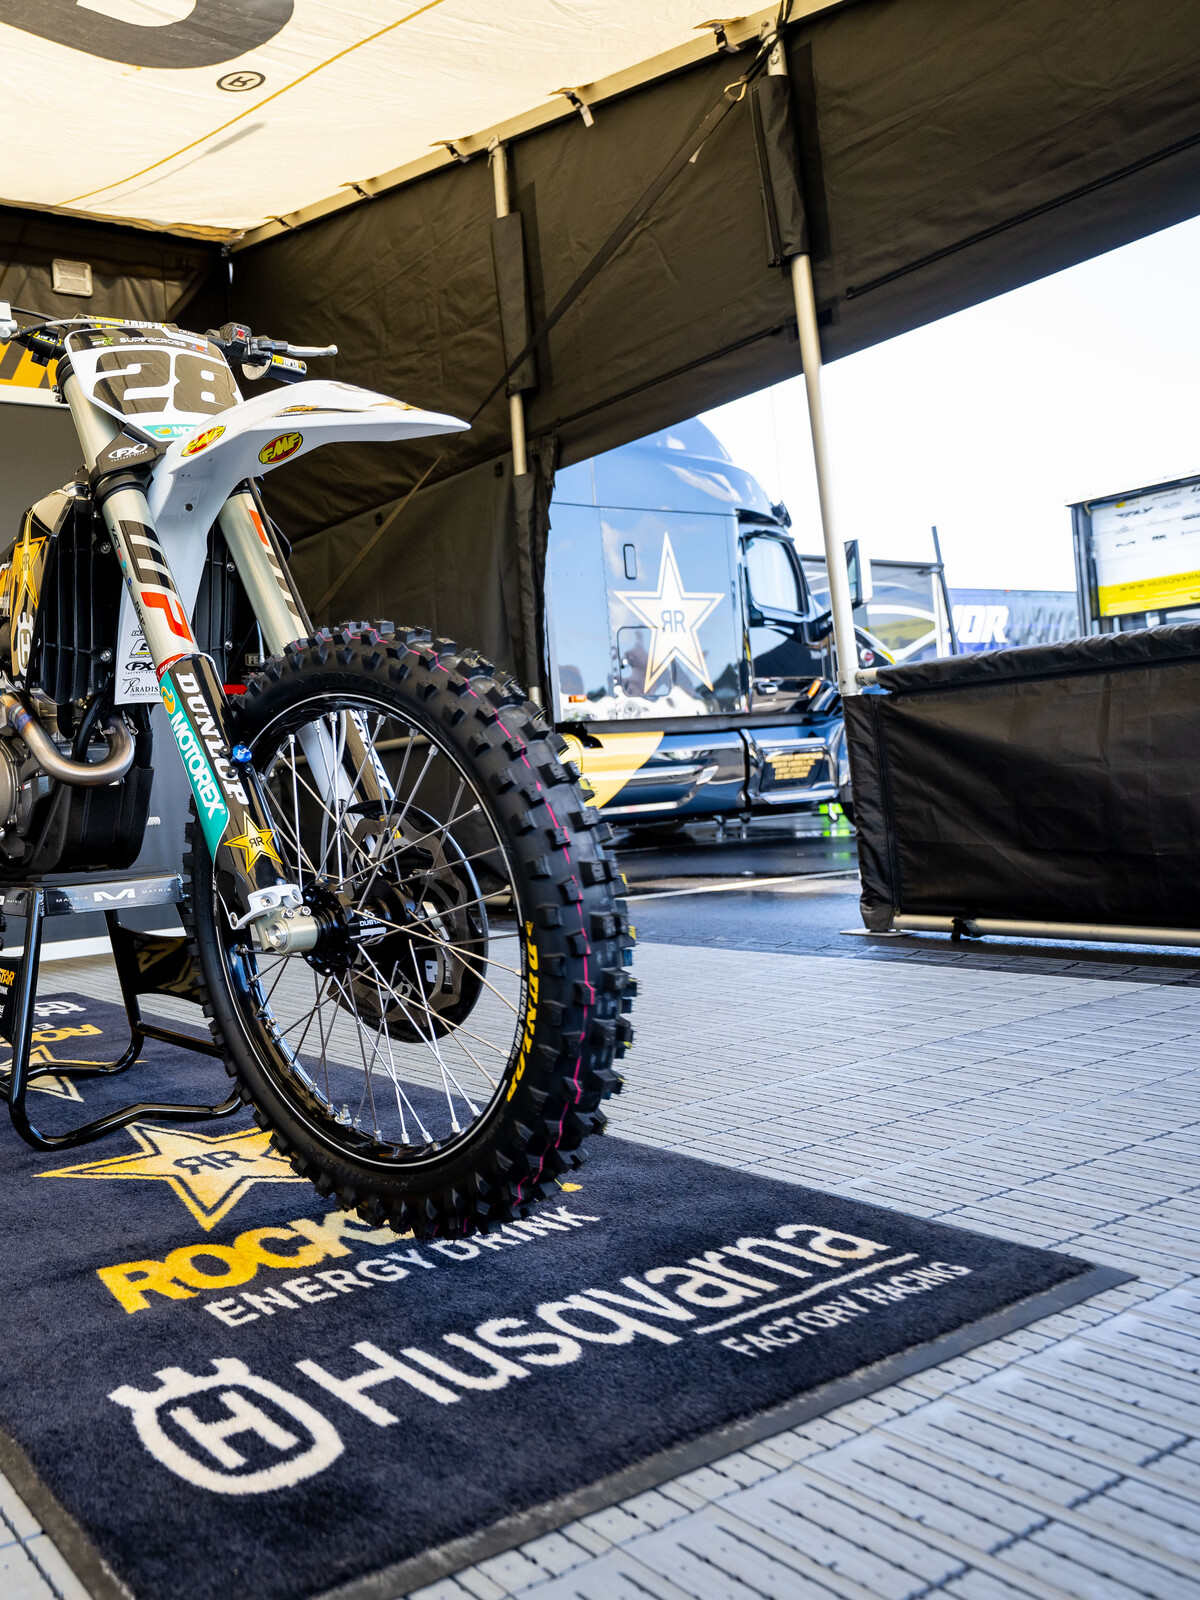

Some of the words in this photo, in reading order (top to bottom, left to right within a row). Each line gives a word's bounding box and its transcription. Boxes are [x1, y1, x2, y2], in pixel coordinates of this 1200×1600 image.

[93, 350, 239, 416] 28
[119, 336, 187, 347] SUPERCROSS
[259, 432, 302, 465] FMF
[170, 711, 226, 820] MOTOREX
[175, 672, 250, 806] DUNLOP
[56, 895, 89, 903] MATRIX
[141, 887, 173, 895] MATRIX
[506, 937, 540, 1102] DUNLOP
[204, 1248, 437, 1328] ENERGY
[429, 1205, 601, 1261] DRINK
[718, 1294, 869, 1358] FACTORY
[850, 1260, 976, 1306] RACING
[295, 1223, 893, 1428] Husqvarna
